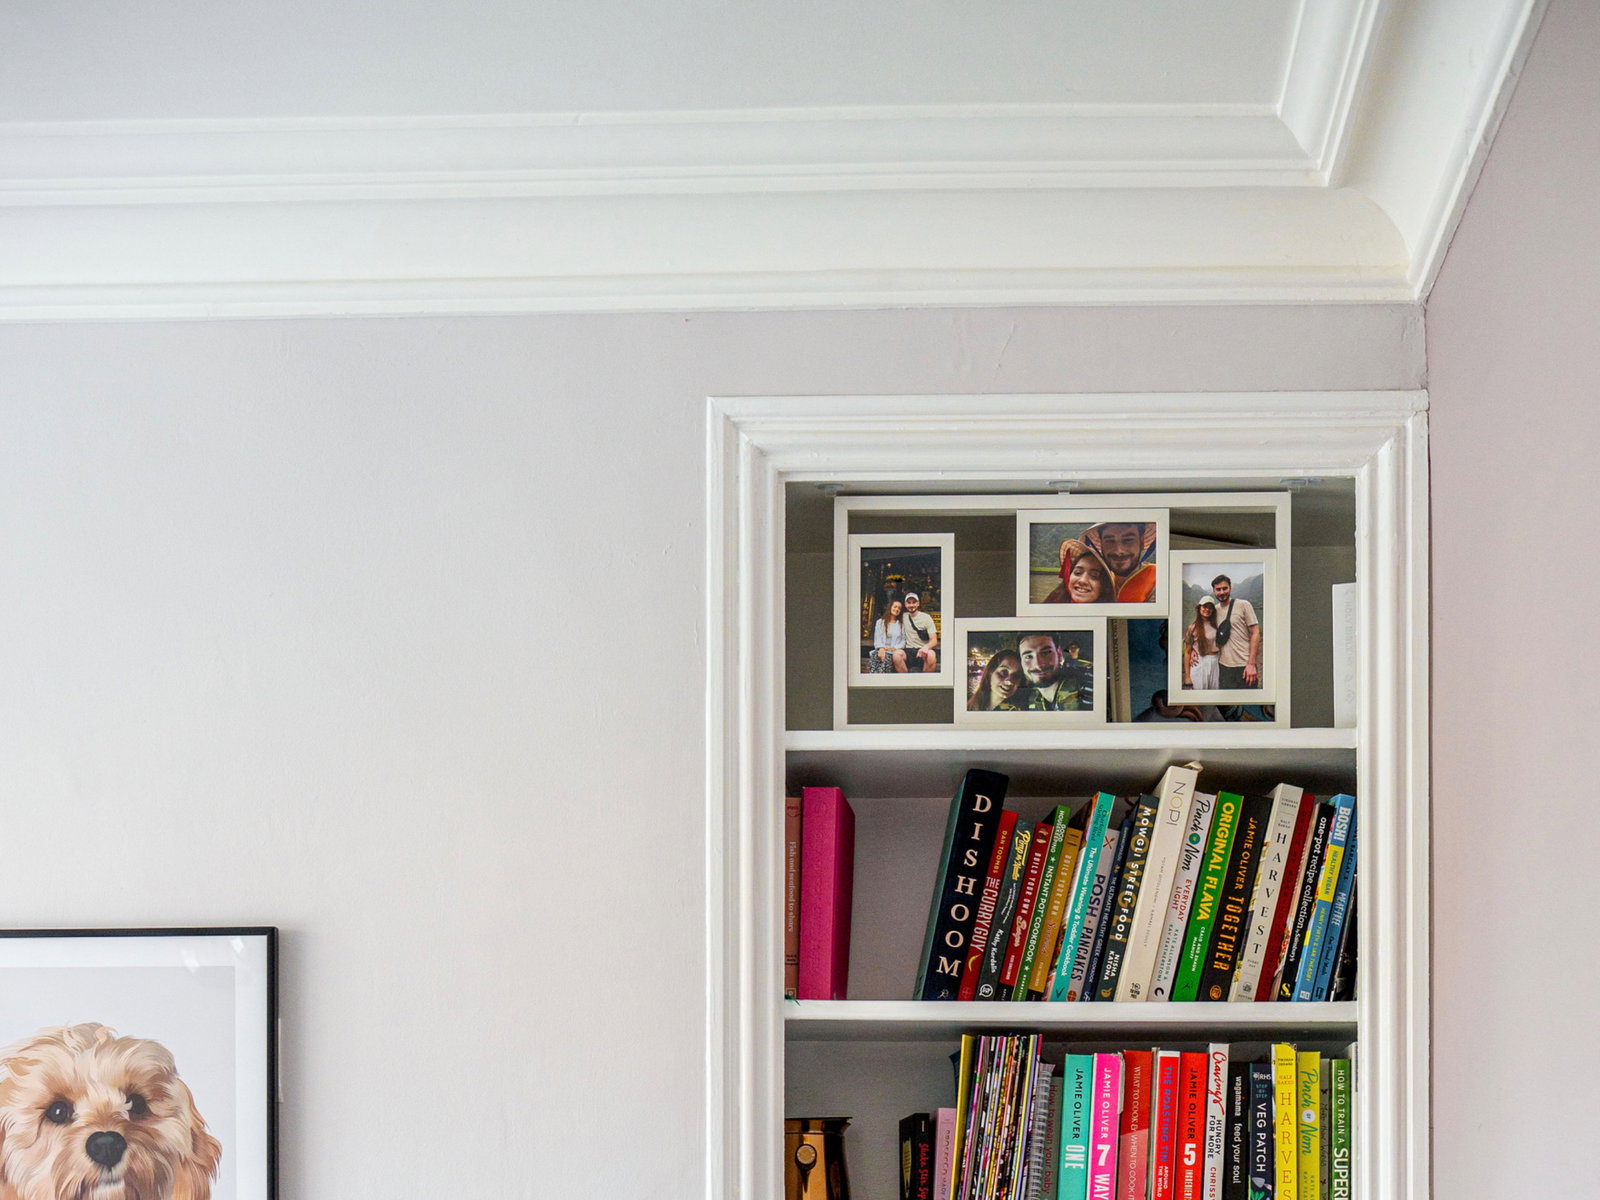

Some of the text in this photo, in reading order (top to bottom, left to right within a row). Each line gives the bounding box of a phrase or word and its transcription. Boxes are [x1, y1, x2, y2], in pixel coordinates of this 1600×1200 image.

[1166, 781, 1187, 826] NOPI
[1050, 810, 1065, 853] HOUSEKEEPING
[1058, 824, 1066, 842] GOOD
[1180, 797, 1213, 874] Pinch Nom
[1312, 816, 1329, 854] one-pot
[1333, 806, 1352, 841] BOSH!
[992, 830, 1008, 874] DAN TOOMBS
[1030, 852, 1042, 875] BUILD
[1089, 847, 1098, 859] The
[1196, 801, 1236, 922] ORIGINAL FLAVA
[1234, 817, 1258, 890] JAMIE OLIVER
[1306, 855, 1321, 884] recipe
[936, 794, 992, 977] DISHOOM
[1025, 877, 1036, 896] YOUR
[1041, 865, 1055, 898] INSTANT
[1082, 859, 1095, 886] Ultimate
[1115, 807, 1153, 941] MOWGLI STREET FOOD
[1324, 850, 1339, 895] HEALTHY VEGAN
[1021, 898, 1031, 914] OWN
[1074, 886, 1088, 914] Weaning
[1105, 885, 1116, 912] ULTIMATE
[1171, 886, 1183, 910] LIGHT
[1176, 879, 1193, 922] EVERYDAY
[1253, 833, 1287, 954] HARVEST
[1297, 885, 1315, 930] collection
[969, 876, 1001, 952] THE CURRY GUY
[1069, 873, 1108, 981] POSH PANCAKES
[1099, 913, 1110, 938] HEALTHY
[1025, 916, 1042, 963] COOKBOOK
[1068, 920, 1080, 944] Toddler
[1094, 938, 1103, 957] GREEK
[1171, 929, 1179, 944] KATE
[1211, 894, 1247, 971] TOGETHER
[986, 928, 1005, 973] Kathy Kordalis
[1061, 944, 1074, 977] Cookbook
[1103, 950, 1116, 981] KATONA
[1110, 954, 1121, 977] NISHA
[1133, 1066, 1141, 1088] WHAT
[1133, 1089, 1140, 1099] TO
[1207, 1051, 1228, 1115] Cravings
[1072, 1069, 1084, 1139] JAMIE OLIVER
[1100, 1068, 1112, 1139] JAMIE OLIVER
[1131, 1101, 1139, 1122] COOK
[1161, 1066, 1173, 1162] THE ROASTING TIN
[1187, 1068, 1198, 1139] JAMIE OLIVER
[1257, 1103, 1266, 1128] VEG
[1300, 1069, 1319, 1155] Pinch Nom
[1338, 1094, 1345, 1105] TO
[1041, 1084, 1058, 1194] How to wean your baby
[1130, 1134, 1138, 1157] WHEN
[1214, 1120, 1222, 1155] HUNGRY
[1232, 1076, 1243, 1184] wagamama feed your soul
[1064, 1144, 1085, 1170] ONE
[1096, 1144, 1111, 1167] 7
[1130, 1159, 1136, 1169] TO
[1184, 1143, 1197, 1166] 5
[1257, 1133, 1266, 1172] PATCH
